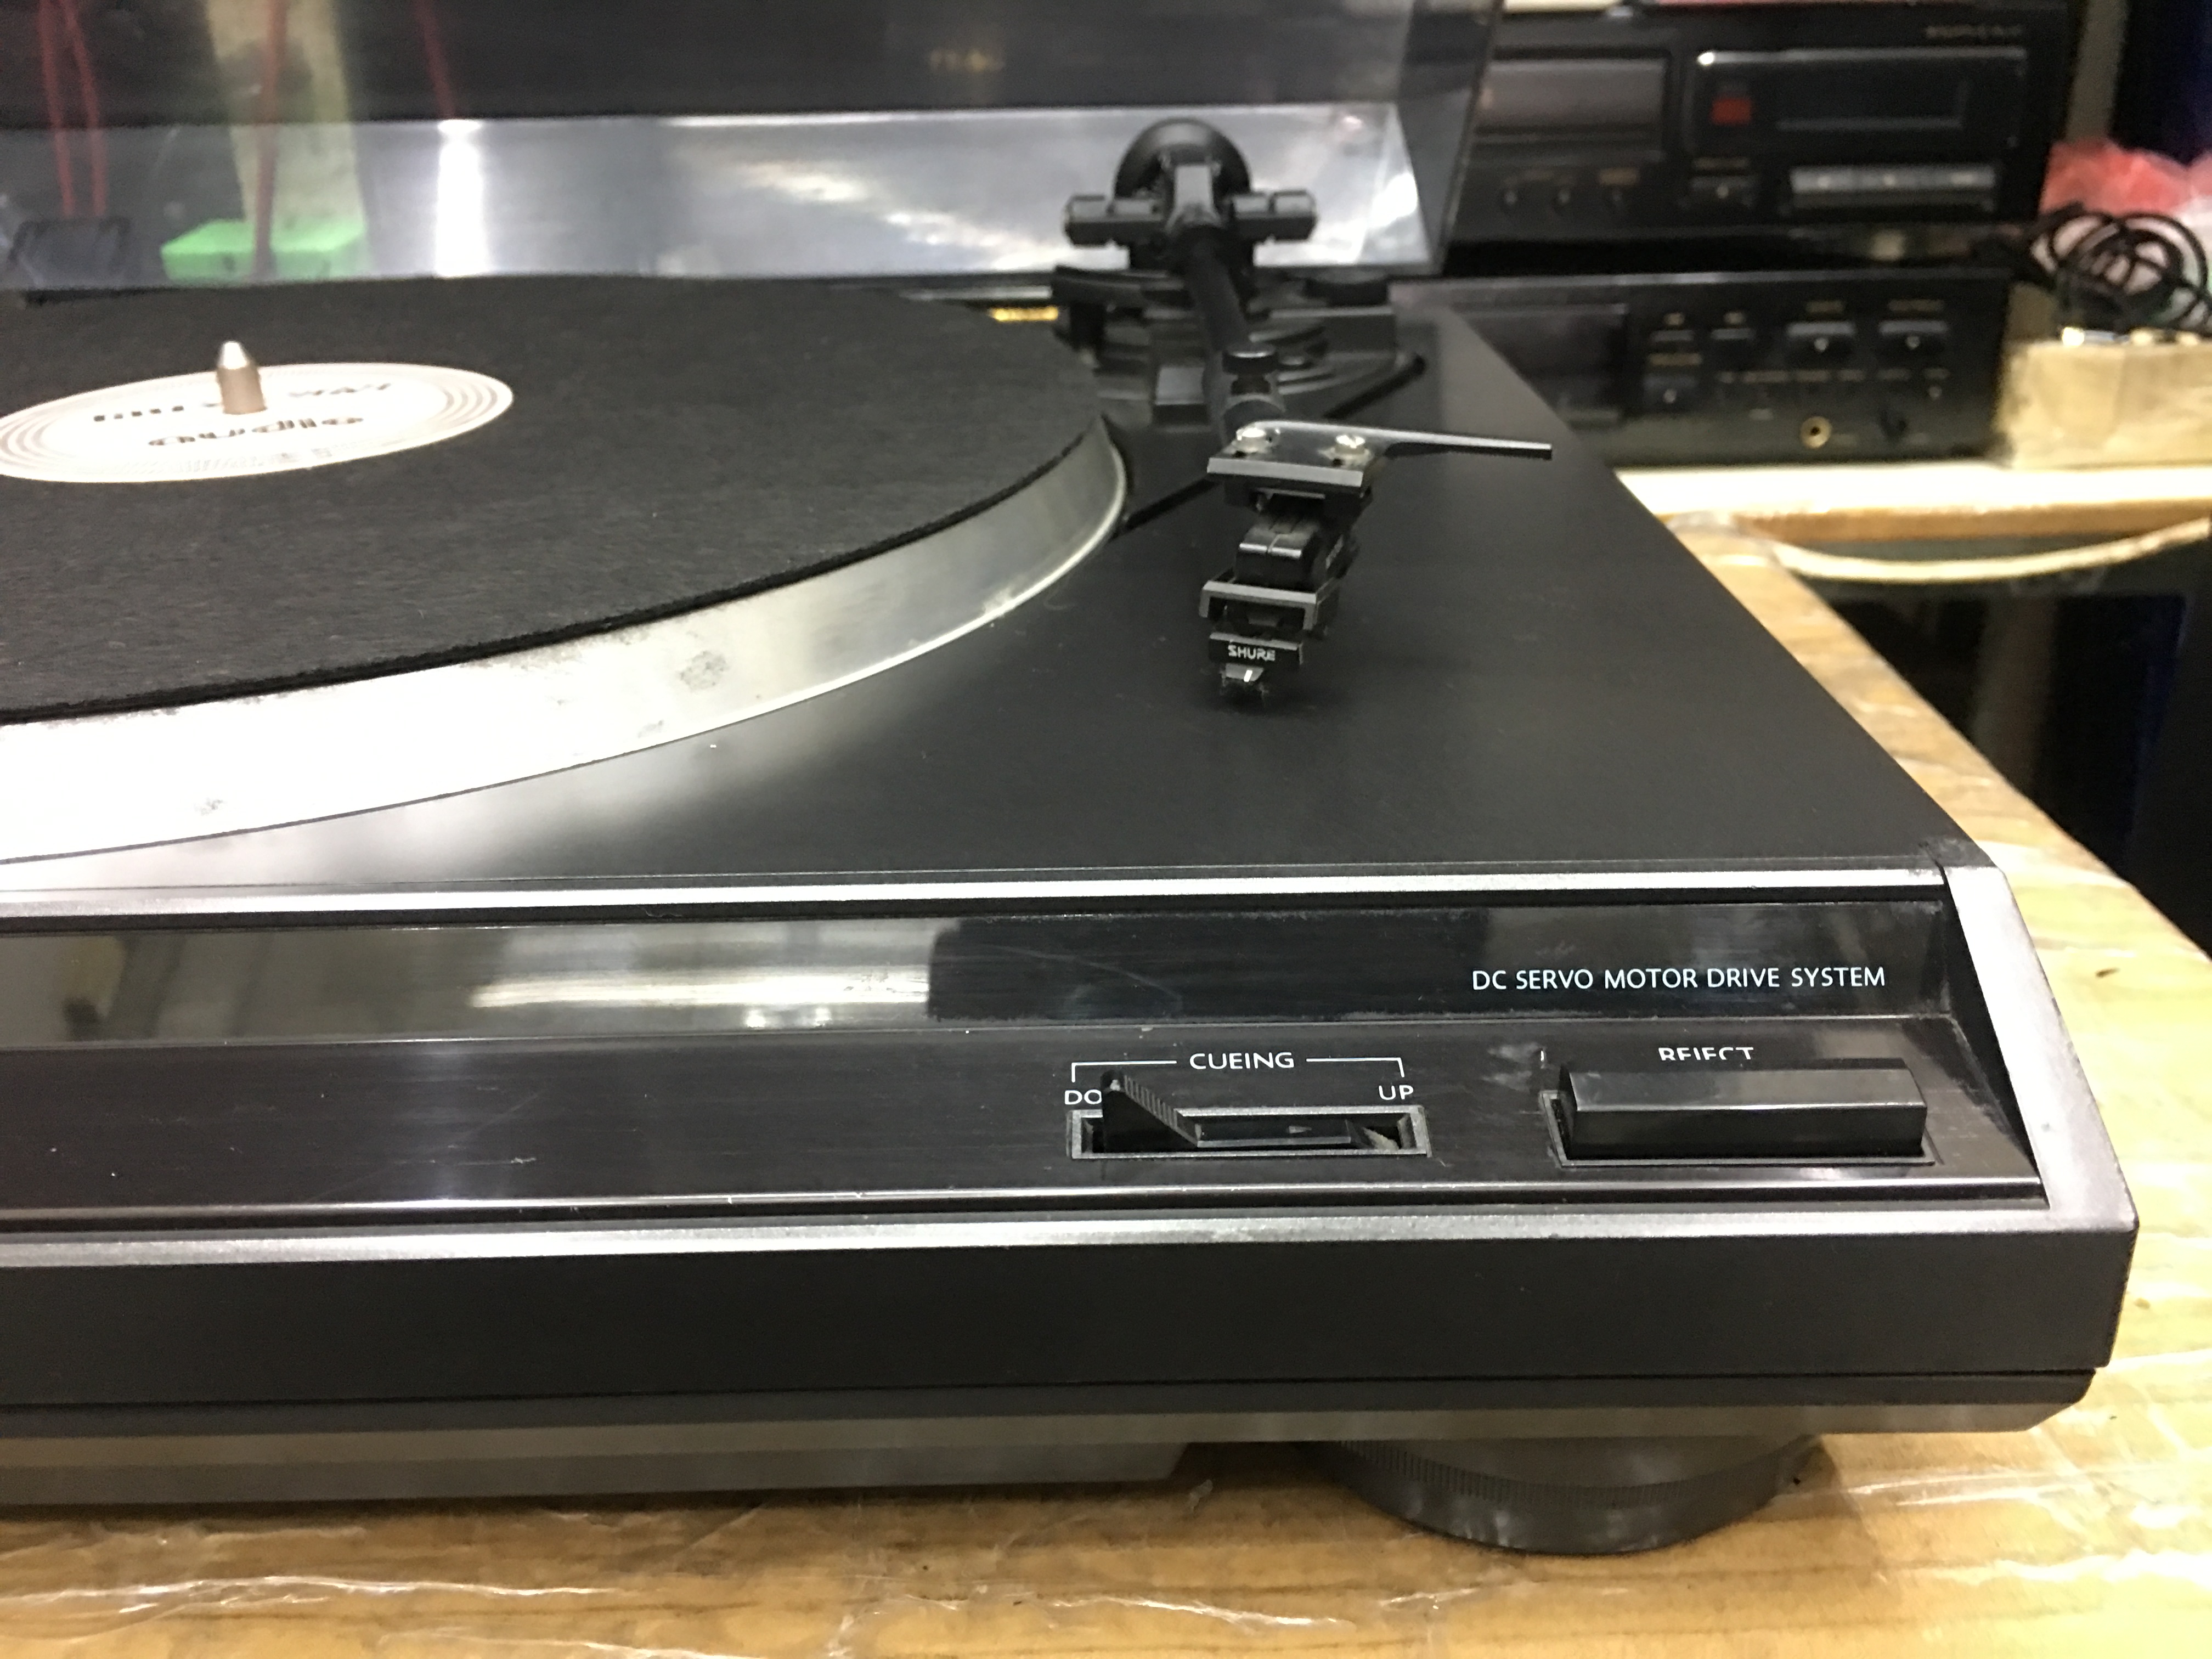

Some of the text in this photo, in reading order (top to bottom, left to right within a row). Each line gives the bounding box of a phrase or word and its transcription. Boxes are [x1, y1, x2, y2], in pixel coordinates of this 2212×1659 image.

[1228, 644, 1276, 662] SHURE
[1472, 966, 1886, 990] DC SERVO MOTOR DRIVE SYSTEM
[1189, 1052, 1295, 1070] CUEING
[1064, 1089, 1102, 1105] DO
[1378, 1085, 1414, 1101] UP
